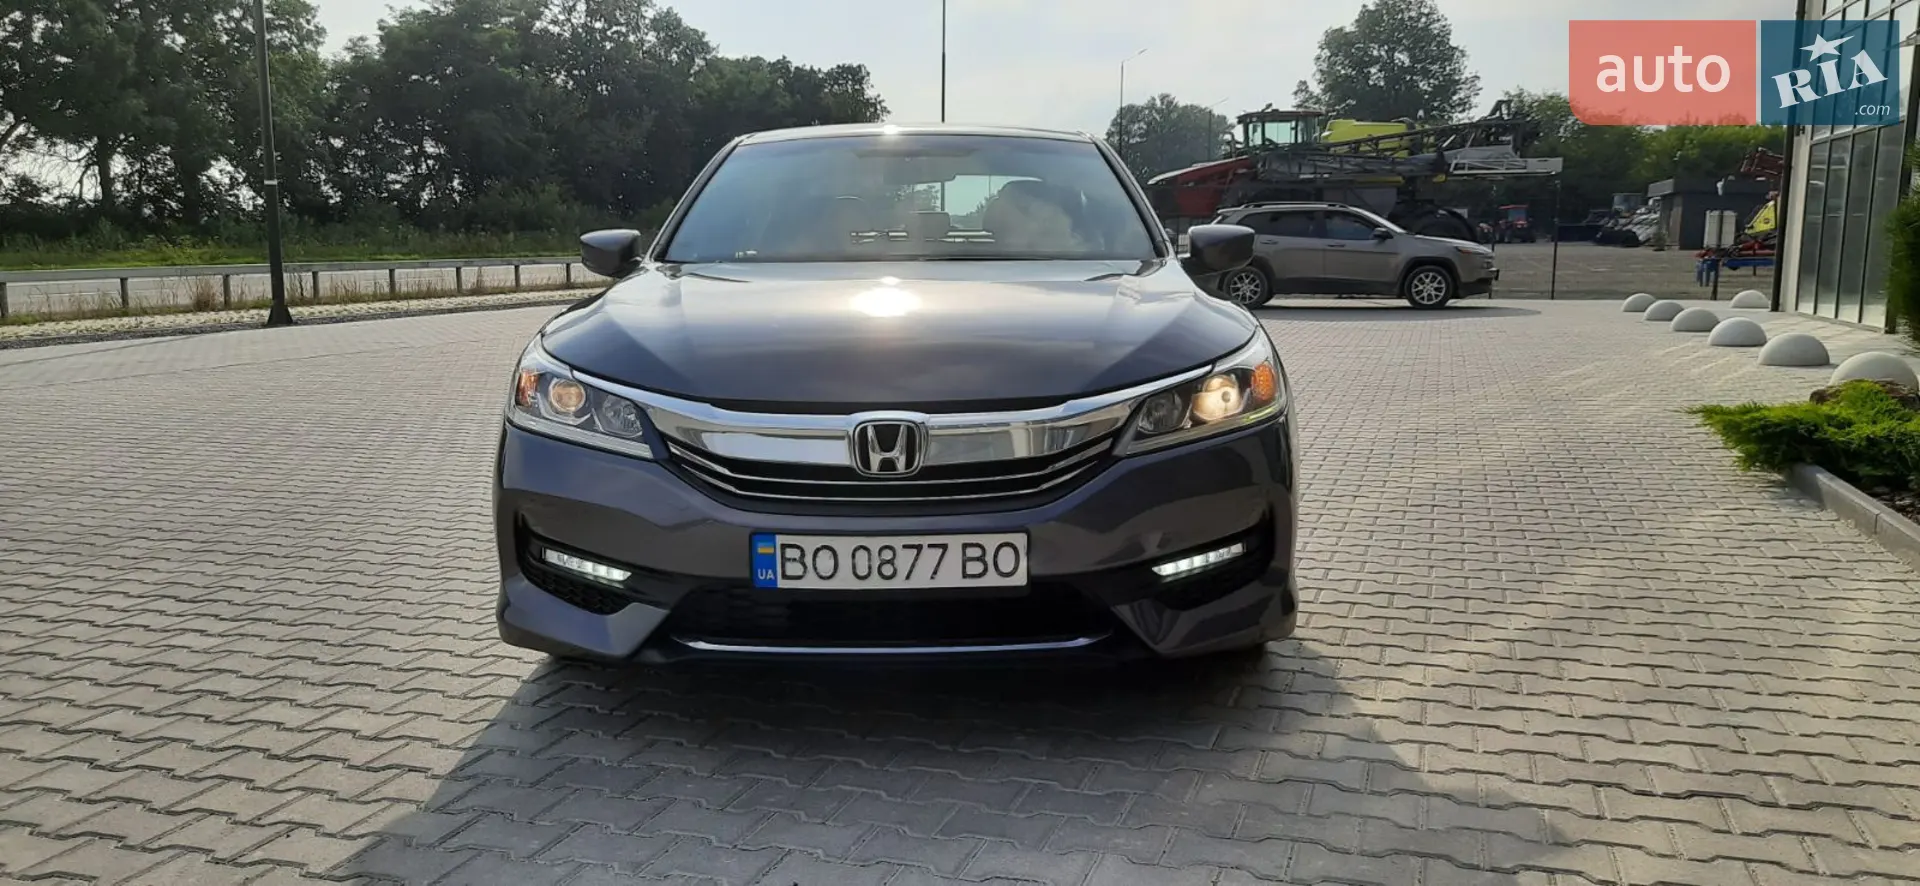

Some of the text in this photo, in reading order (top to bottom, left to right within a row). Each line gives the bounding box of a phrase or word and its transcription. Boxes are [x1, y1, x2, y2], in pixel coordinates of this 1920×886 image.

[780, 541, 1021, 581] BO 0877 BO
[757, 569, 775, 580] UA
